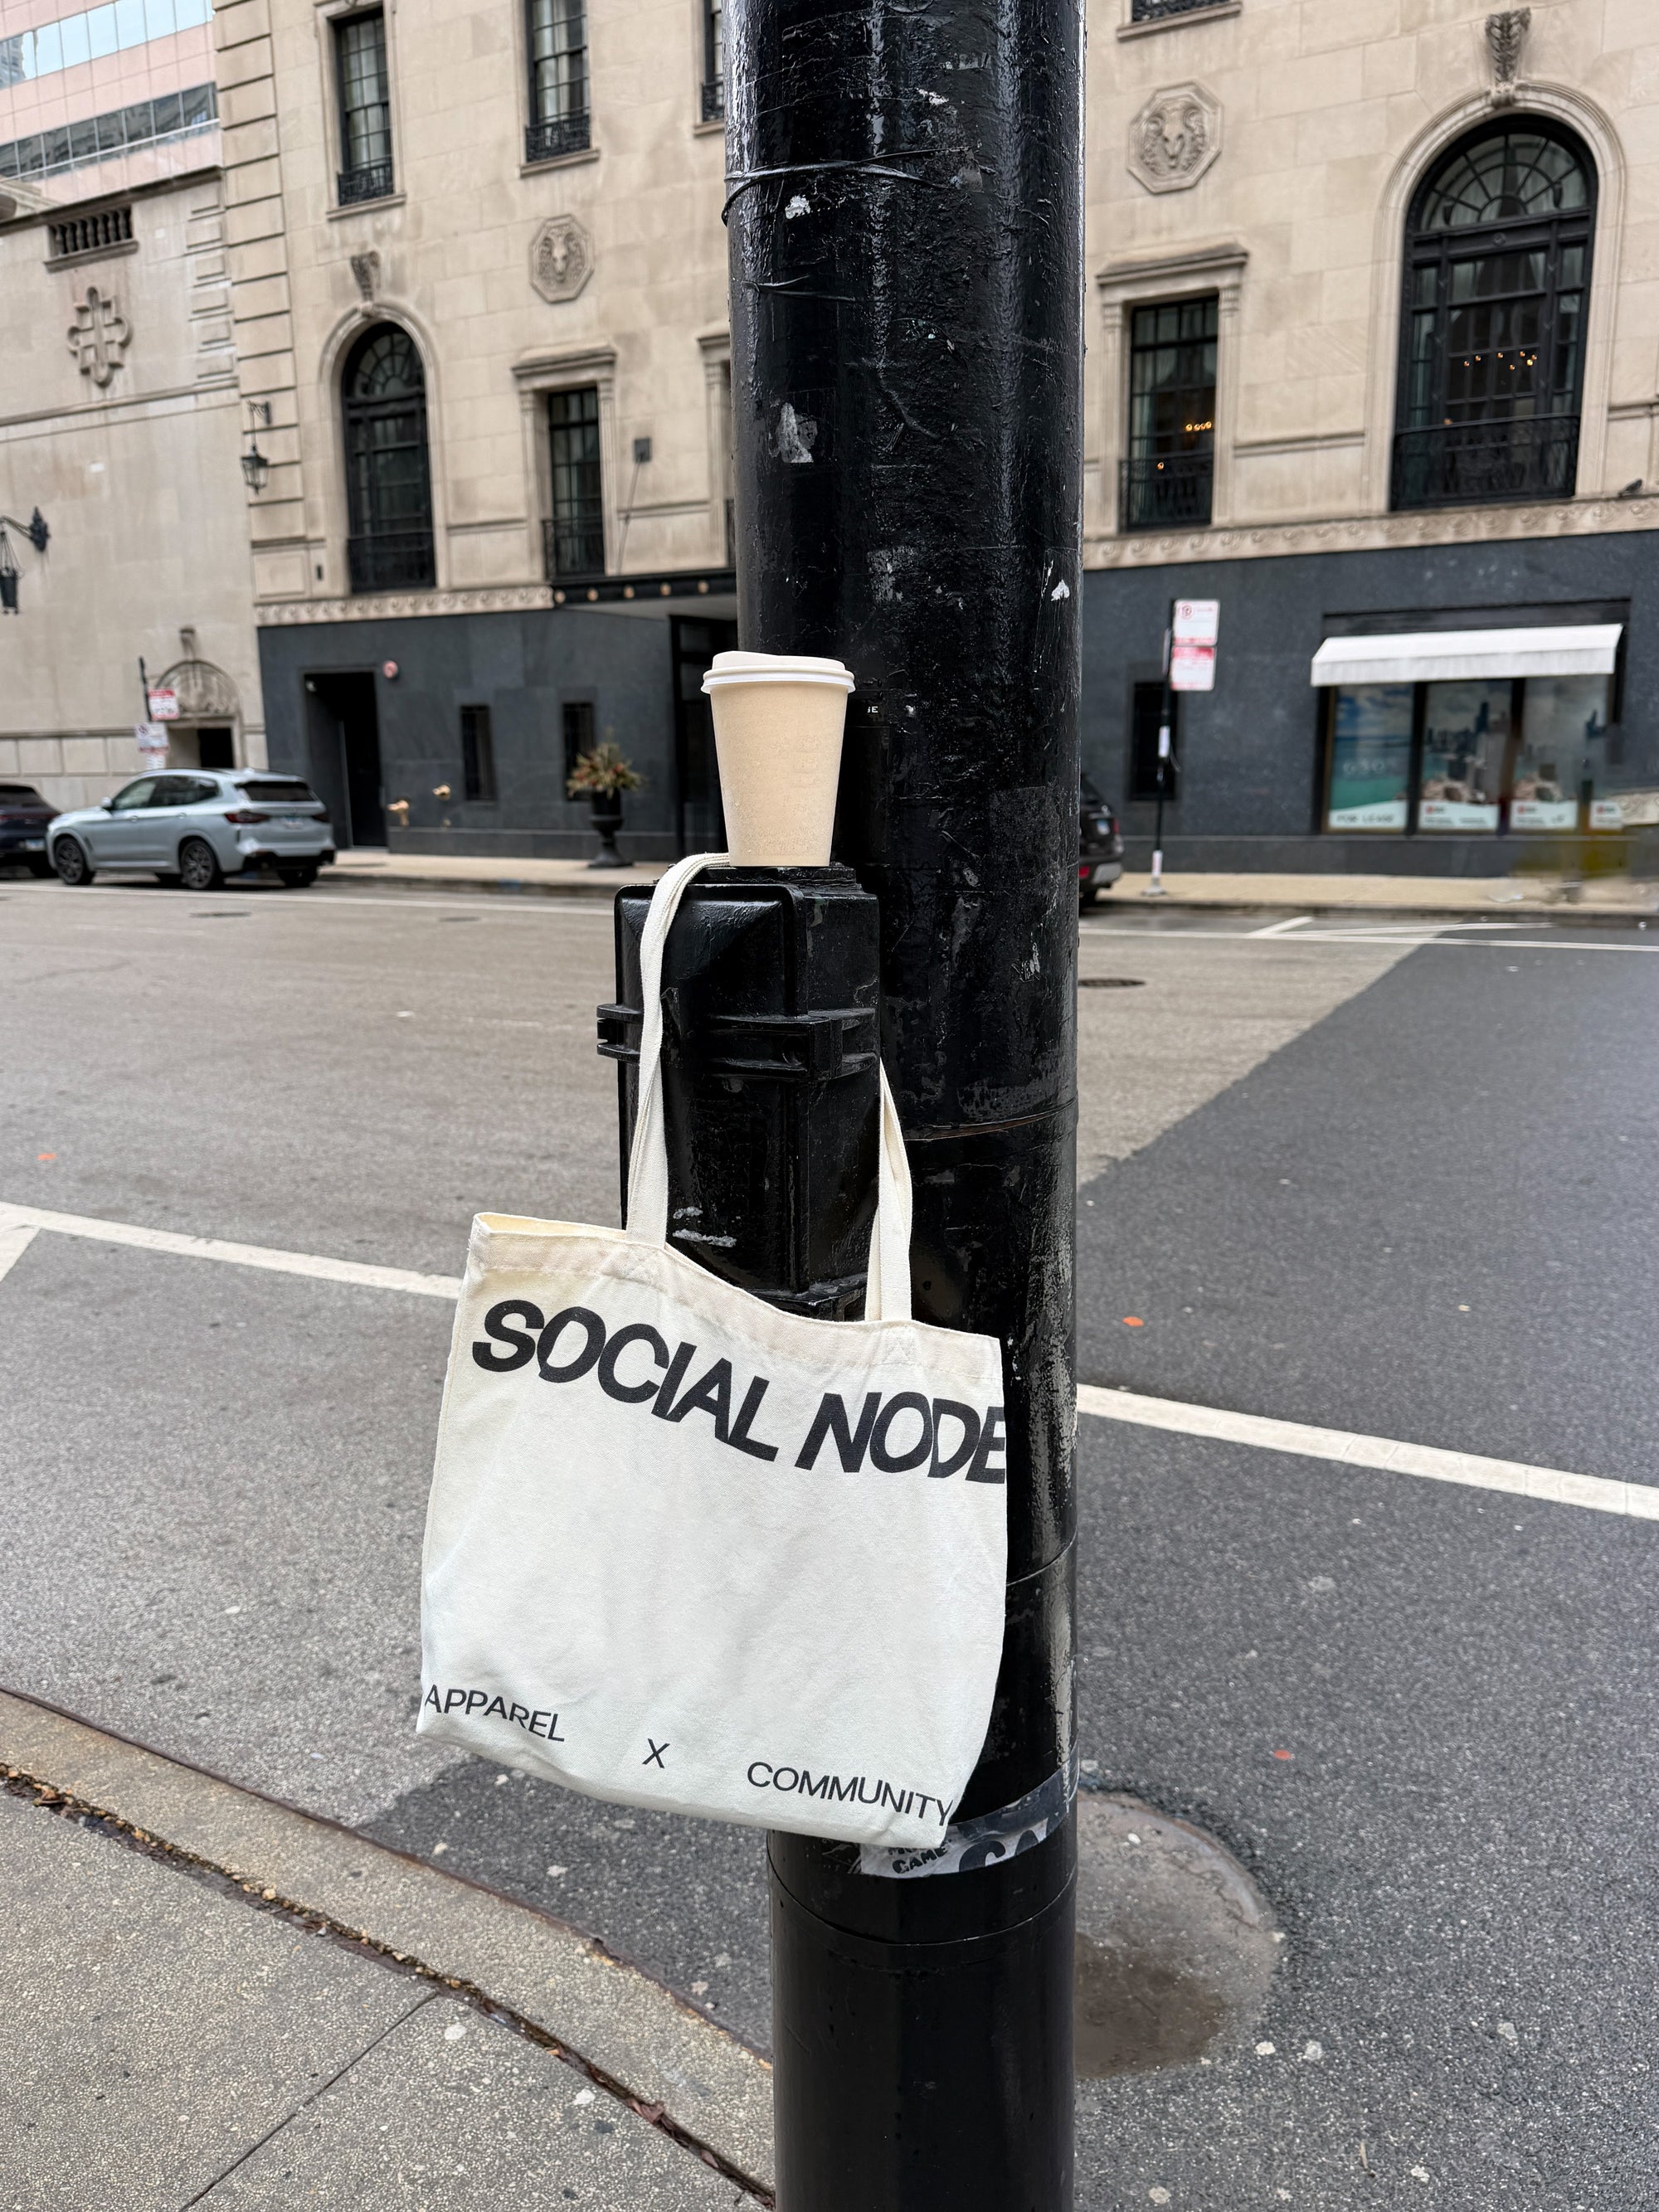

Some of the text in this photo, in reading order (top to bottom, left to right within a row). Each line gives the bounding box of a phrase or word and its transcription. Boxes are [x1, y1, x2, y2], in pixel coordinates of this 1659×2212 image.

[472, 1299, 1005, 1485] SOCIAL NODE
[424, 1684, 565, 1742] APPAREL
[747, 1762, 954, 1826] COMMUNITY
